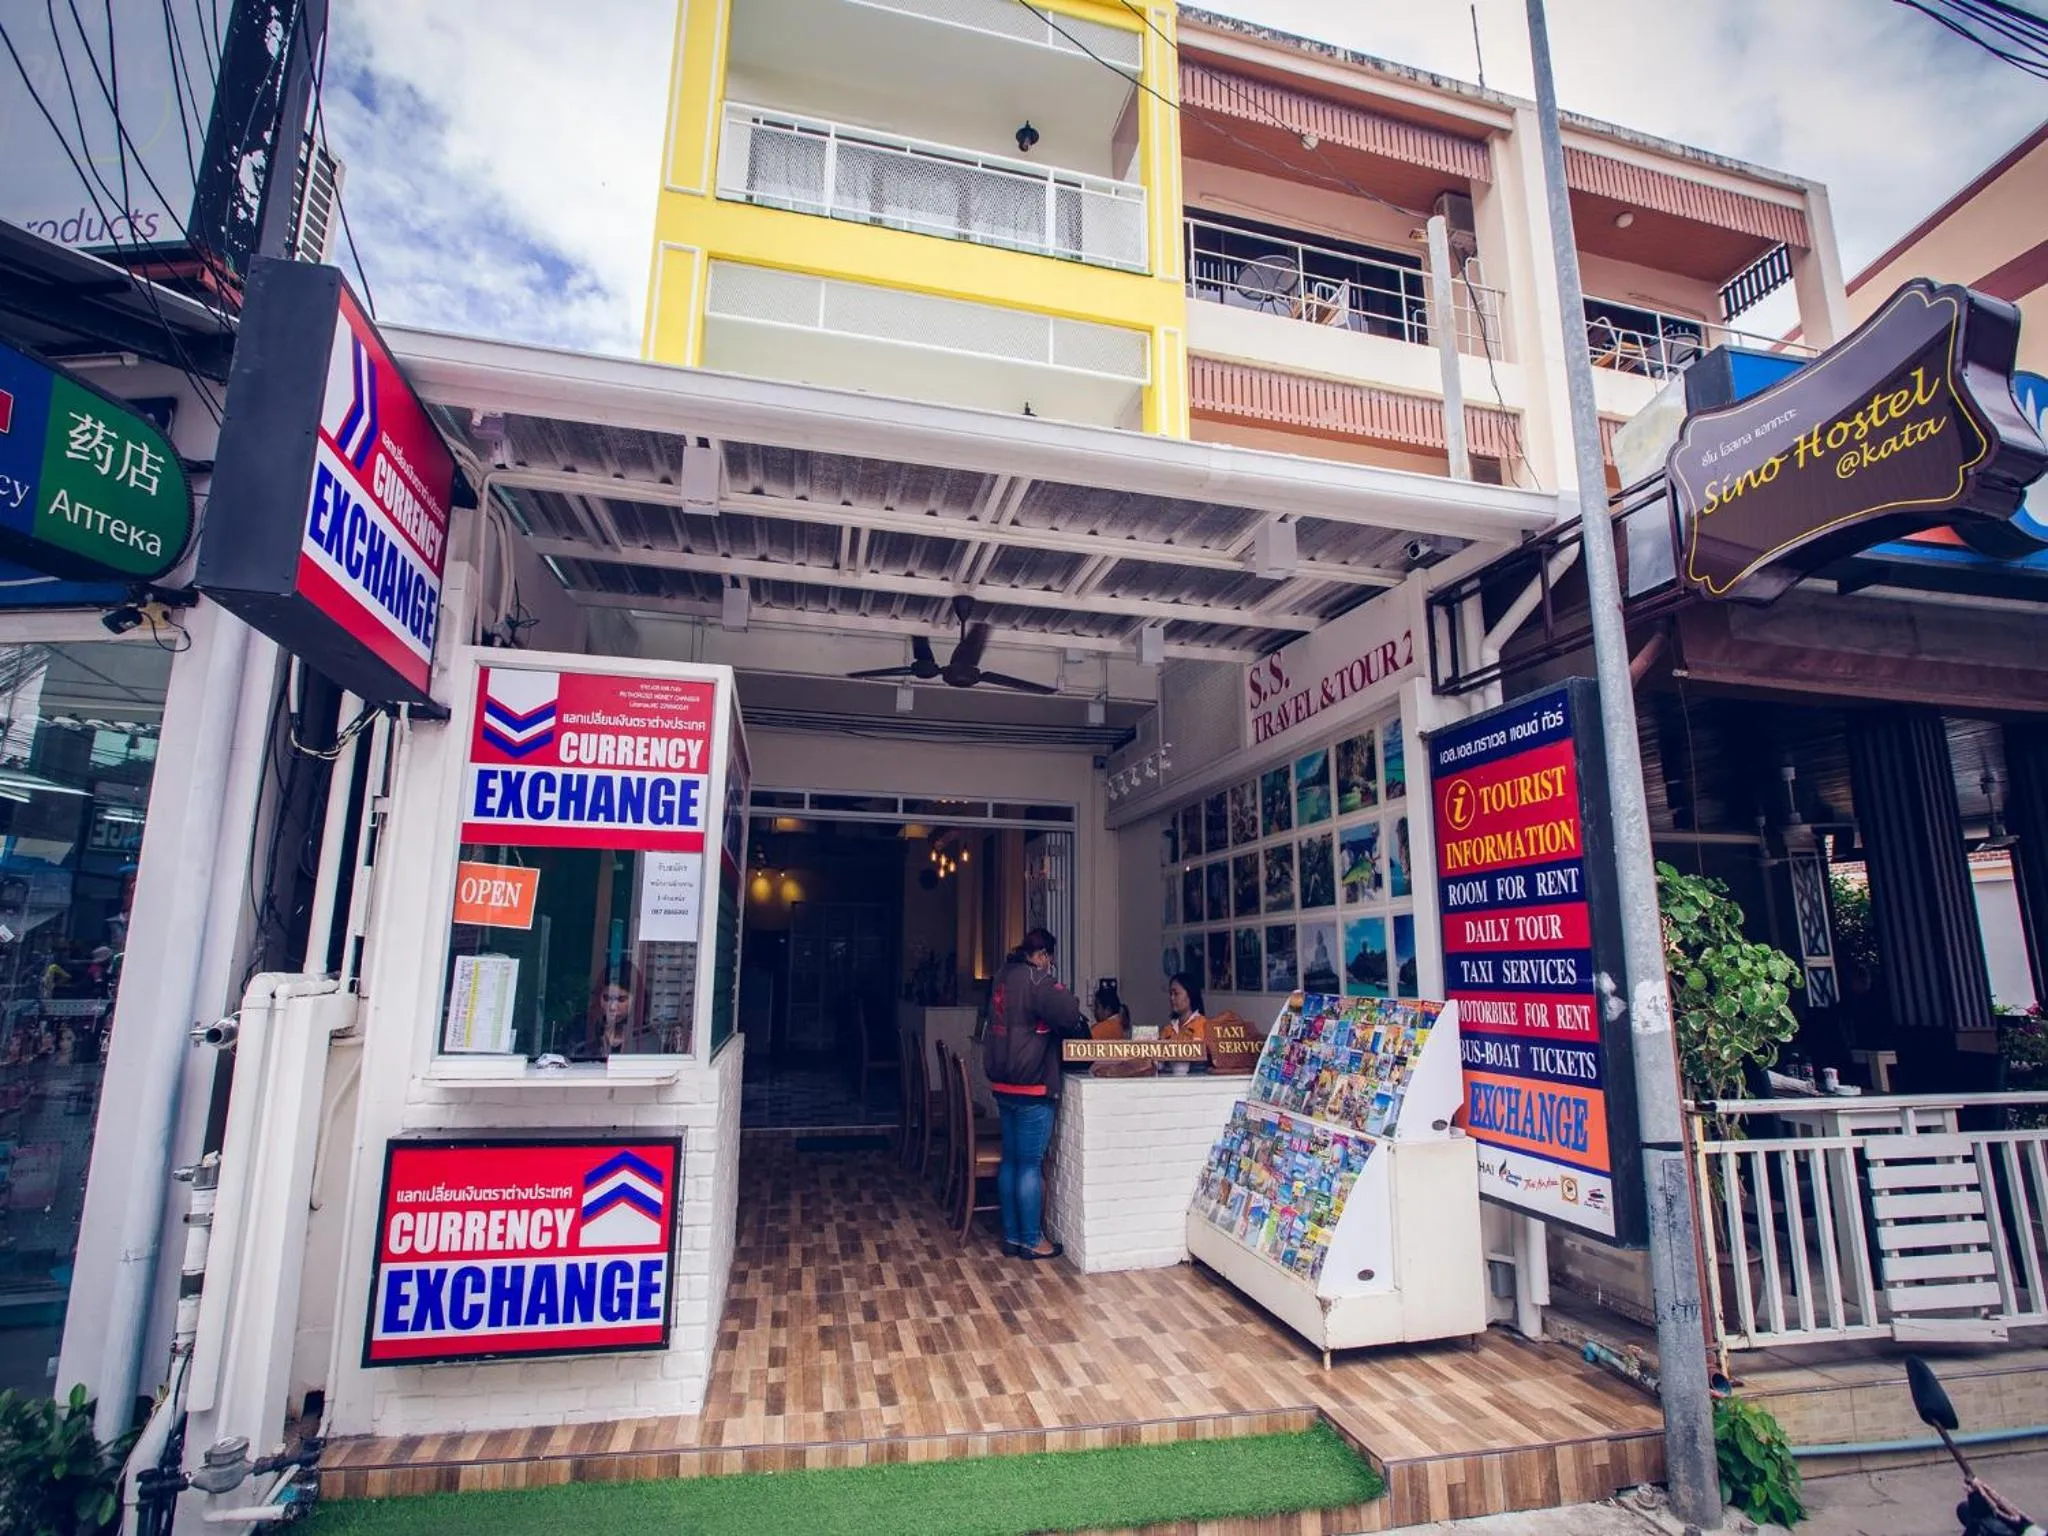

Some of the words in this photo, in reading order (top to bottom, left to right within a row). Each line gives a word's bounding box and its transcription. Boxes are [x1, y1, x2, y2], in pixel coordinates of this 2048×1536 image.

[65, 411, 165, 496] 药店
[1703, 454, 1788, 514] Sino
[1793, 367, 1940, 469] Hostel
[1836, 416, 1947, 479] @kata
[49, 488, 161, 557] Аптека
[373, 452, 444, 567] CURRENCY
[308, 460, 437, 649] EXCHANGE
[559, 731, 704, 769] CURRENCY
[473, 769, 700, 826] EXCHANGE
[1479, 766, 1566, 815] TOURIST
[1446, 819, 1576, 870] INFORMATION
[461, 877, 522, 908] OPEN
[1448, 880, 1488, 906] ROOM
[1496, 874, 1527, 901] FOR
[1536, 868, 1579, 896] RENT
[1465, 918, 1510, 944] DAILY
[1515, 915, 1563, 941] TOUR
[1461, 960, 1494, 983] TAXI
[1503, 958, 1577, 985] SERVICES
[1213, 1026, 1245, 1038] TAXI
[1524, 1003, 1549, 1028] FOR
[1556, 1004, 1591, 1031] RENT
[1068, 1043, 1109, 1058] TOUR
[1110, 1043, 1201, 1058] INFORMATION
[1530, 1046, 1597, 1080] TICKETS
[1469, 1081, 1588, 1153] EXCHANGE
[396, 1182, 573, 1203] แลกเปลี่ยนเงินตราต่างประเทศ
[388, 1207, 576, 1255] CURRENCY
[382, 1259, 663, 1333] EXCHANGE
